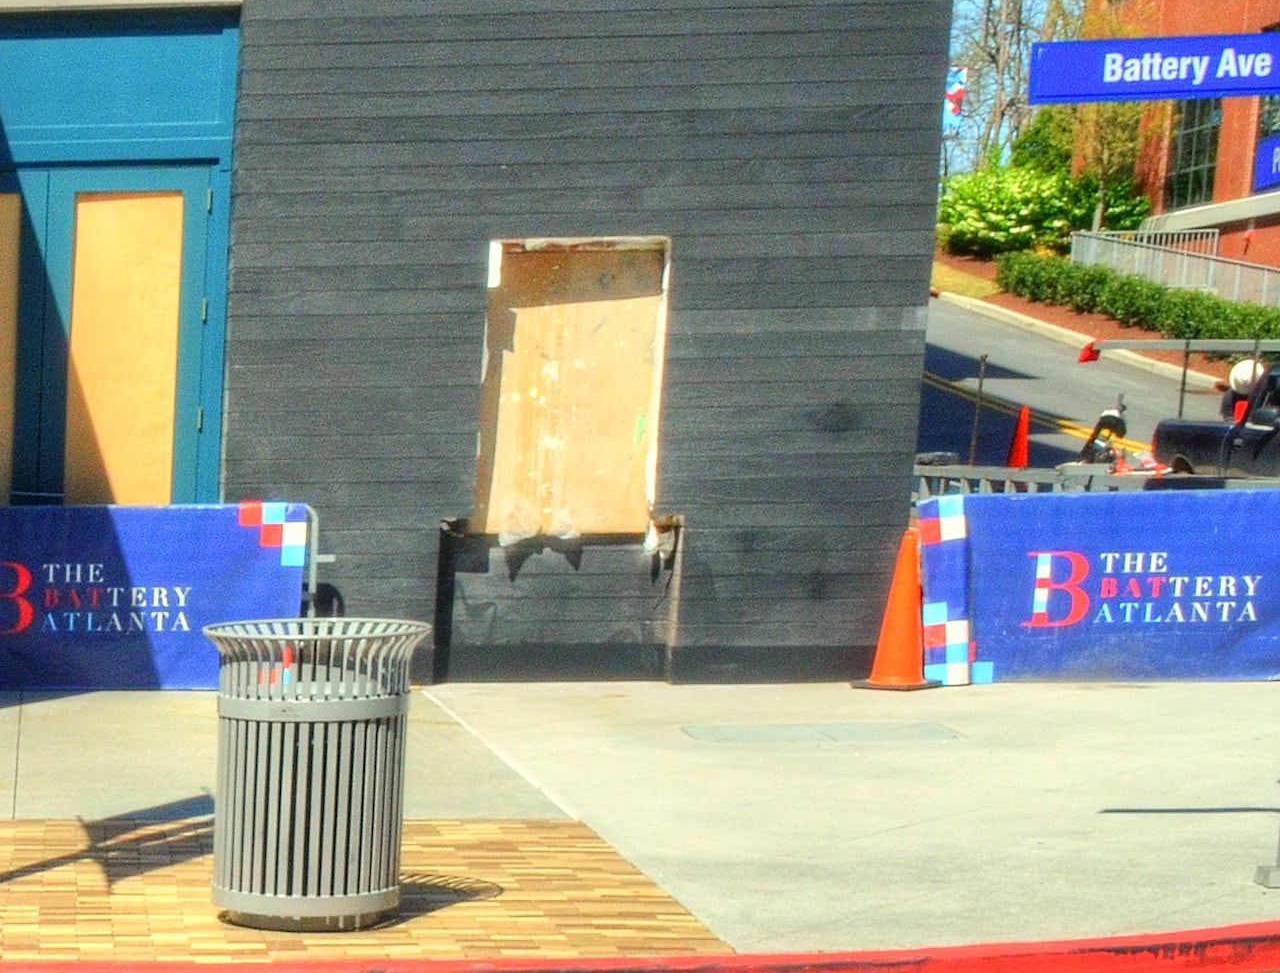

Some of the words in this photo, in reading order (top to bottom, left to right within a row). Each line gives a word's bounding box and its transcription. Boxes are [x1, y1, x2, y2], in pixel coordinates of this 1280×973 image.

[1102, 51, 1210, 85] Battery
[1215, 46, 1272, 78] Ave
[42, 562, 105, 584] THE
[1100, 551, 1168, 574] THE
[43, 586, 193, 609] BATTERY
[1099, 575, 1263, 599] BATTERY
[41, 610, 193, 633] ATLANTA
[1092, 600, 1259, 624] ATLANTA
